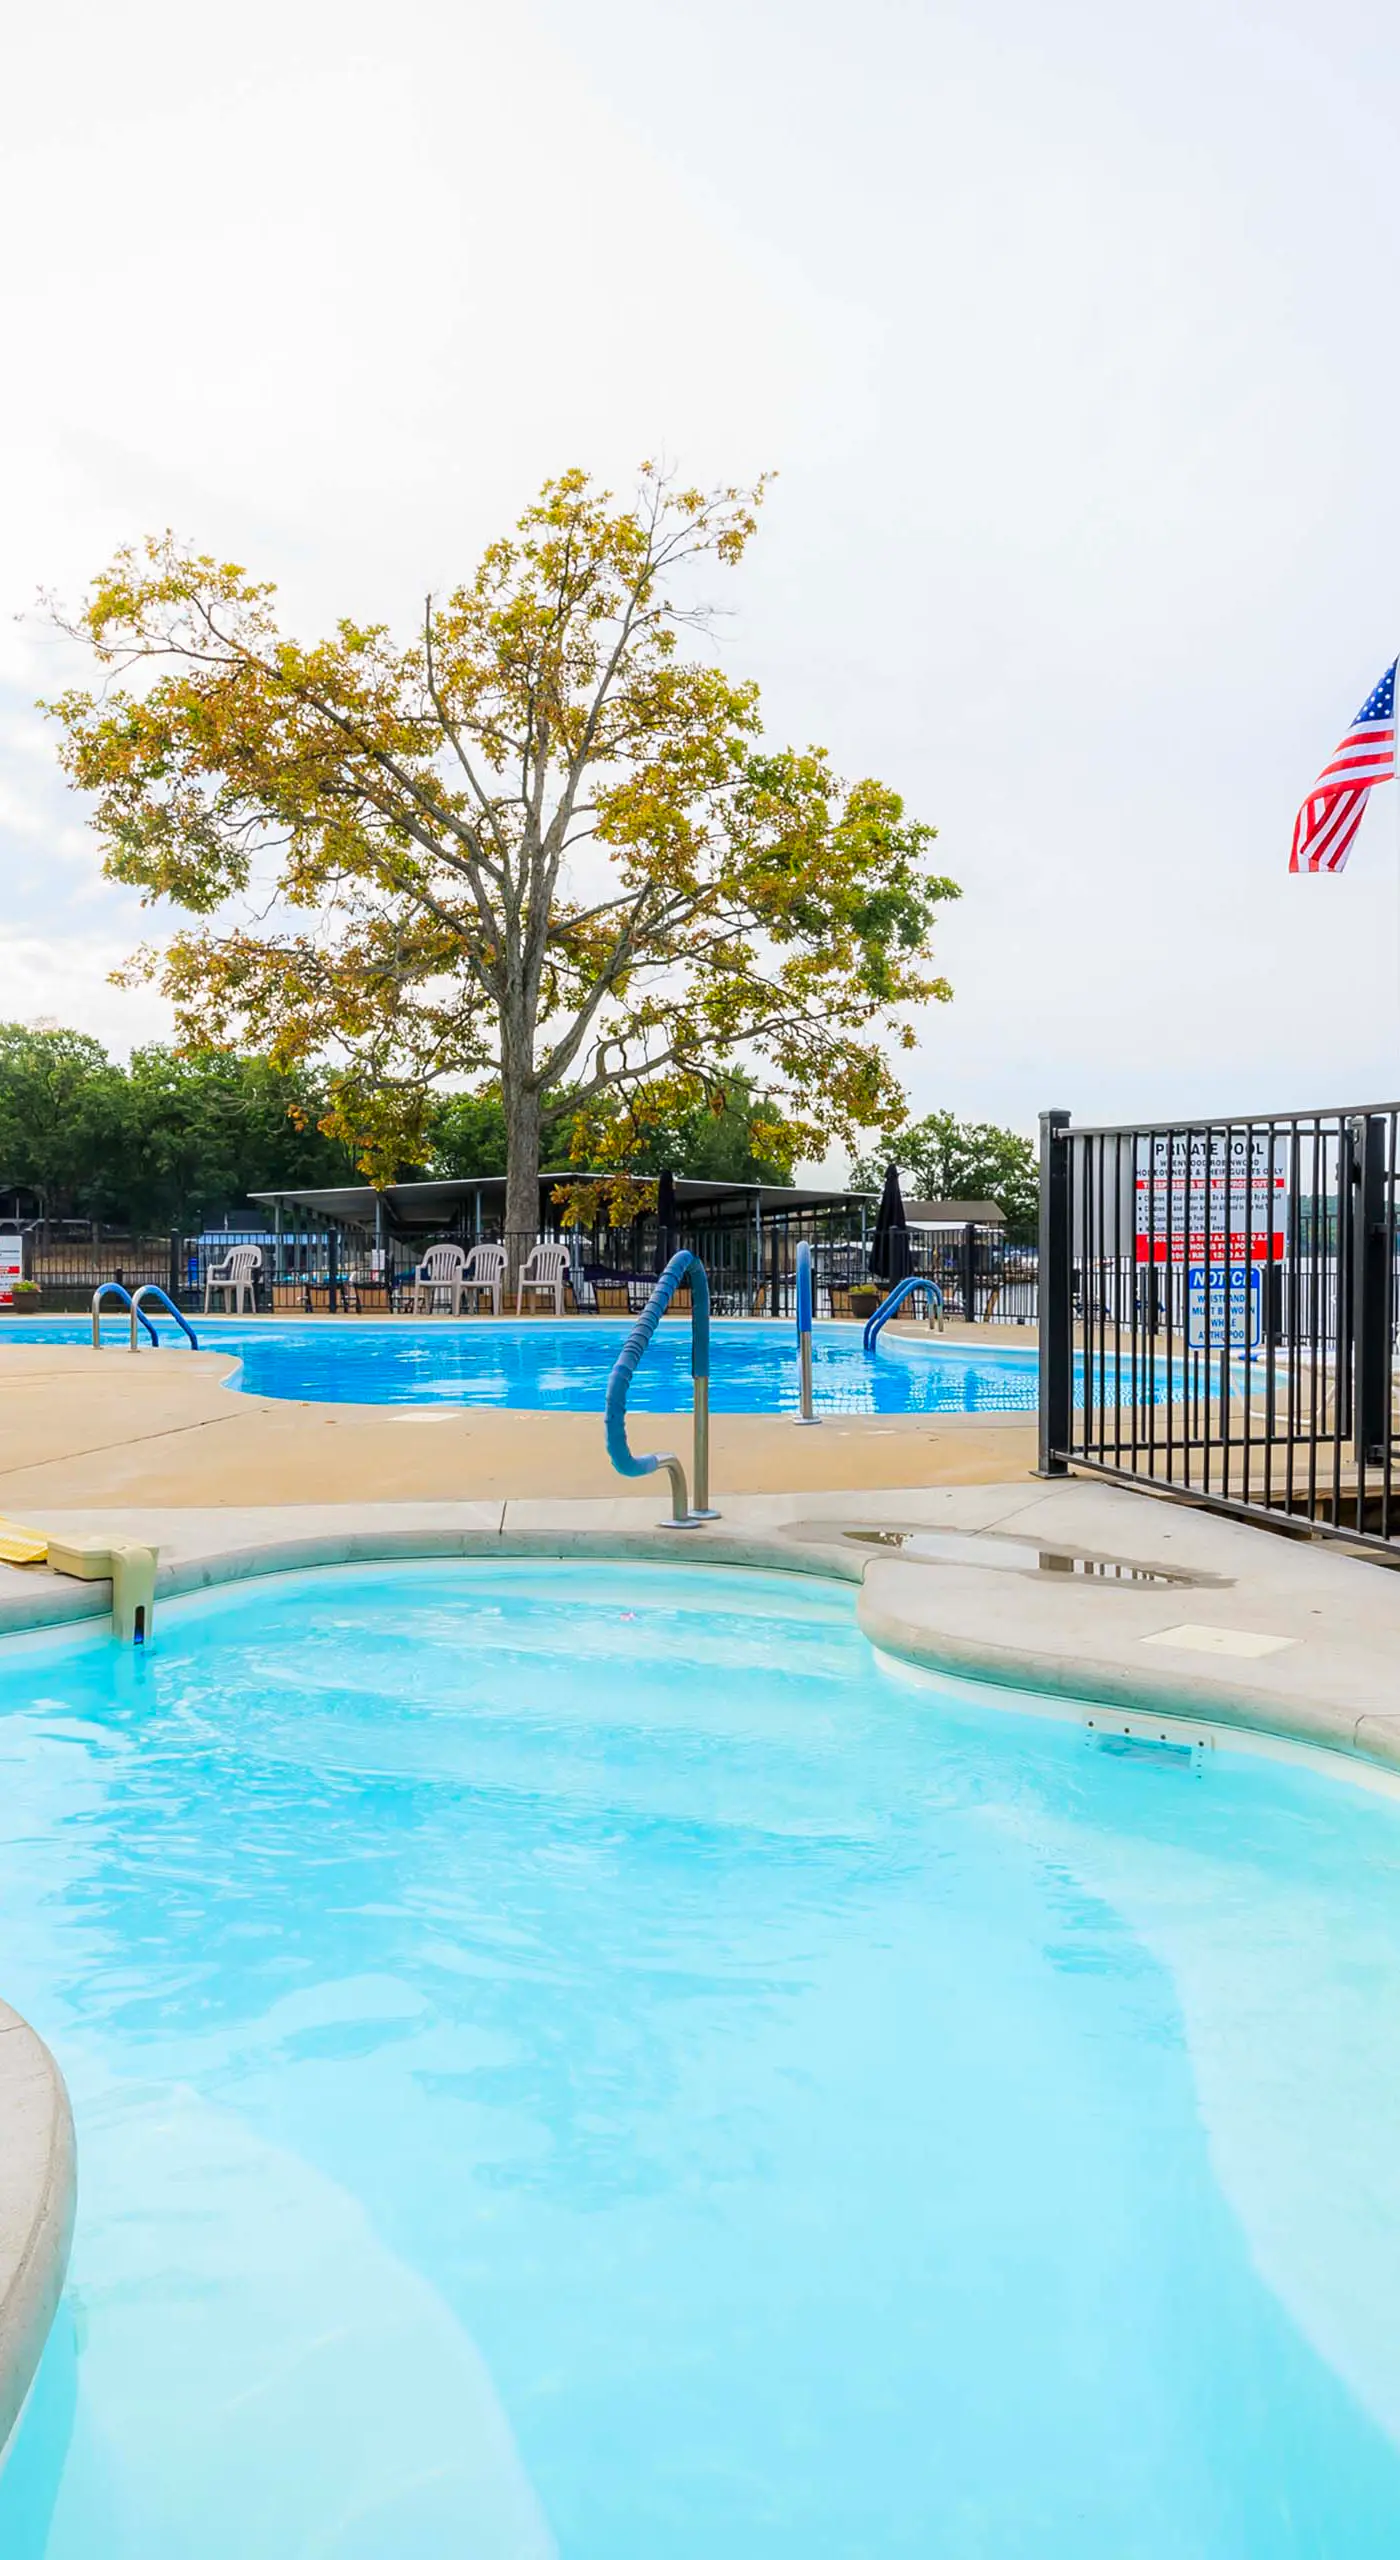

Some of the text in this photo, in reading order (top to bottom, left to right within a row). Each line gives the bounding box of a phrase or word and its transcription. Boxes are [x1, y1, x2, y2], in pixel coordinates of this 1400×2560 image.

[1204, 1168, 1227, 1176] HEIR
[1229, 1168, 1260, 1176] GUETS
[1193, 1271, 1254, 1287] NOTC
[1197, 1294, 1248, 1303] WISTAND
[1192, 1307, 1215, 1315] MUT
[1230, 1306, 1255, 1314] WON
[1211, 1318, 1236, 1327] WHE
